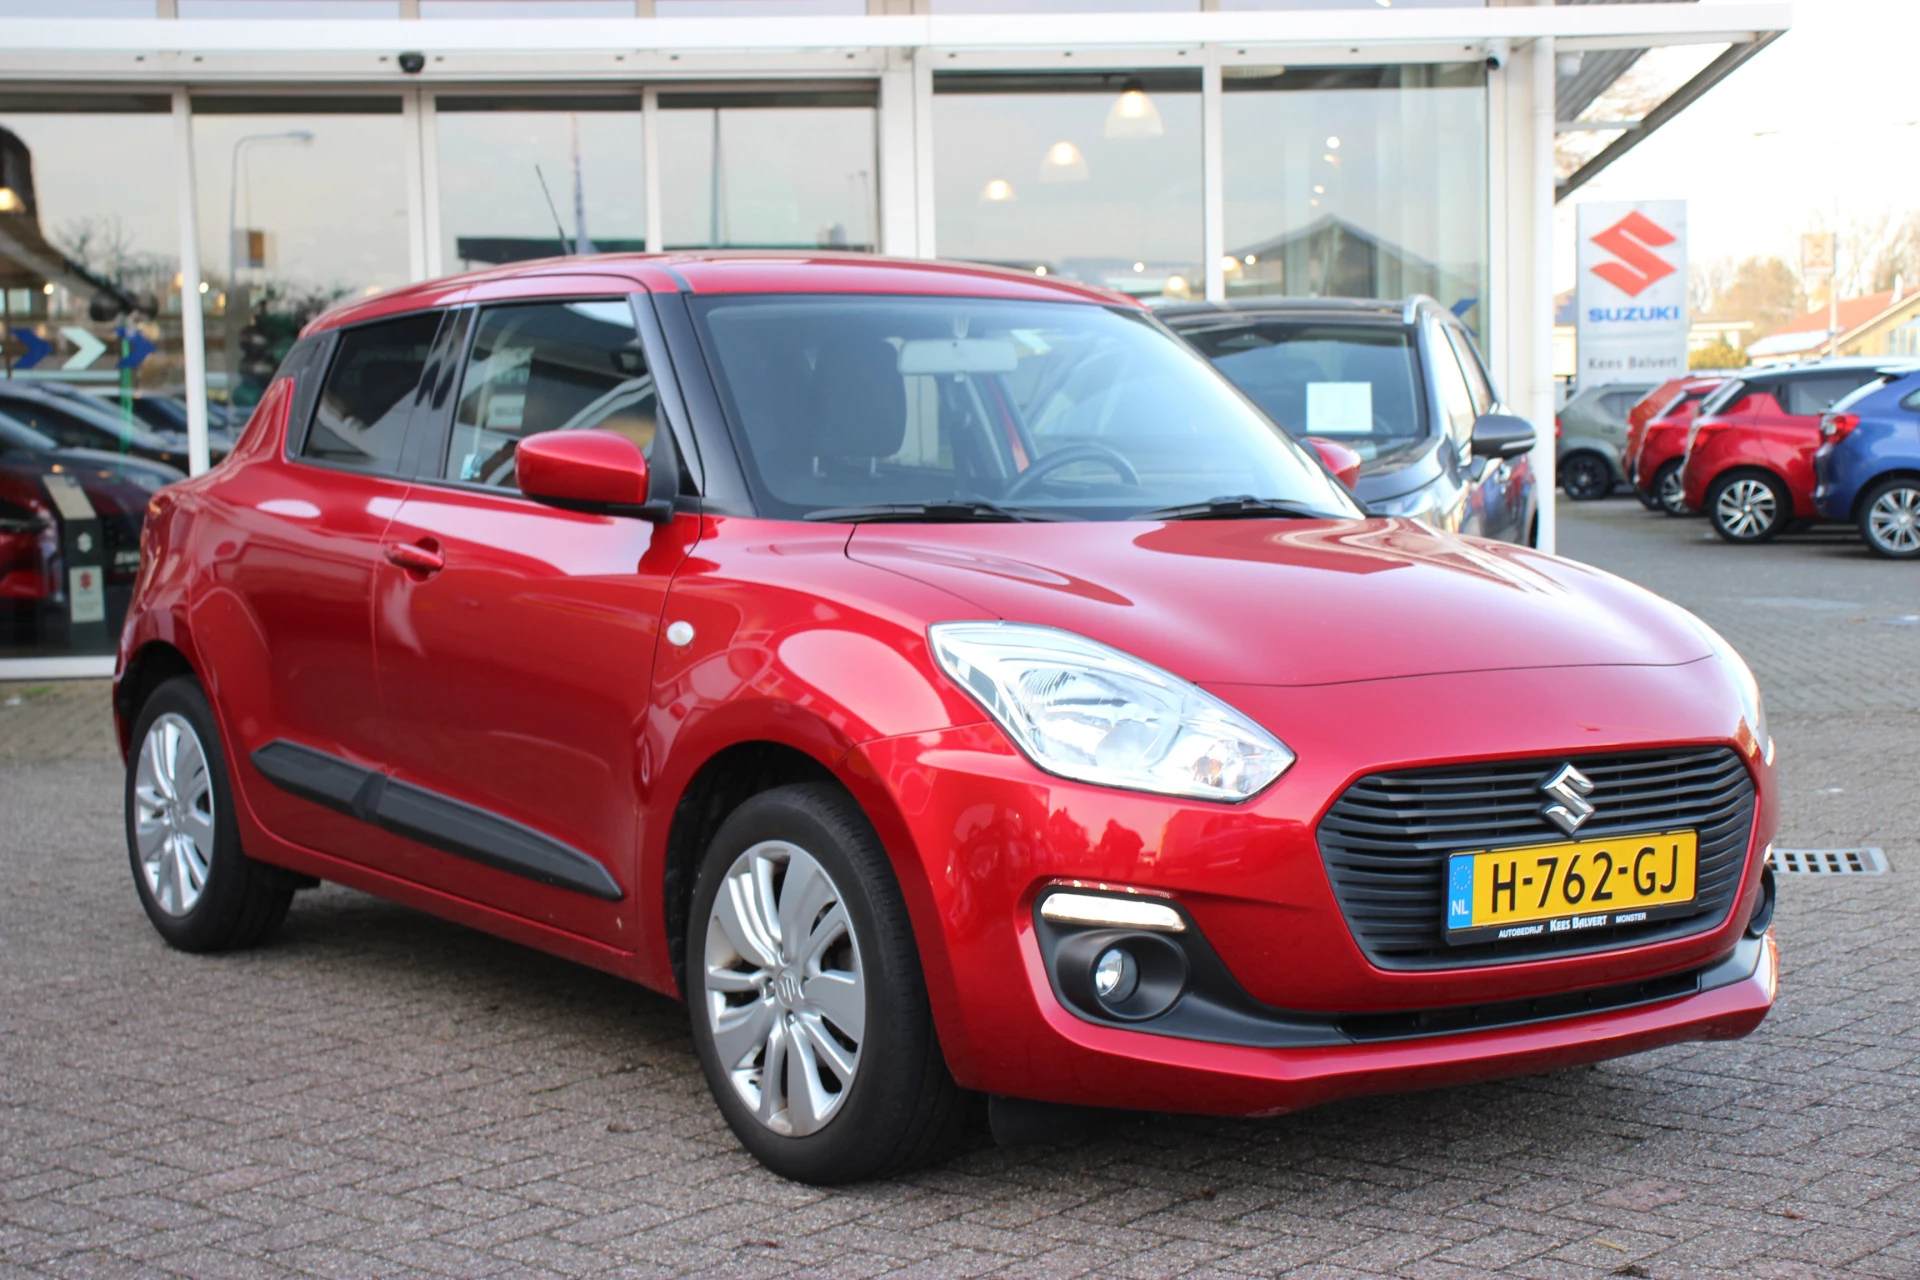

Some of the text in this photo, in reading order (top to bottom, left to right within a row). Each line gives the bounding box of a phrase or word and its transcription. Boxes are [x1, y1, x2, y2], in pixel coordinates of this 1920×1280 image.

[1588, 306, 1680, 322] SUZUKI
[1588, 356, 1677, 370] Kees Balvert
[1491, 844, 1678, 913] H-762-GJ
[1452, 900, 1469, 916] NL
[1498, 925, 1544, 938] AUTOBEDRIJF
[1615, 912, 1647, 923] MONSTER
